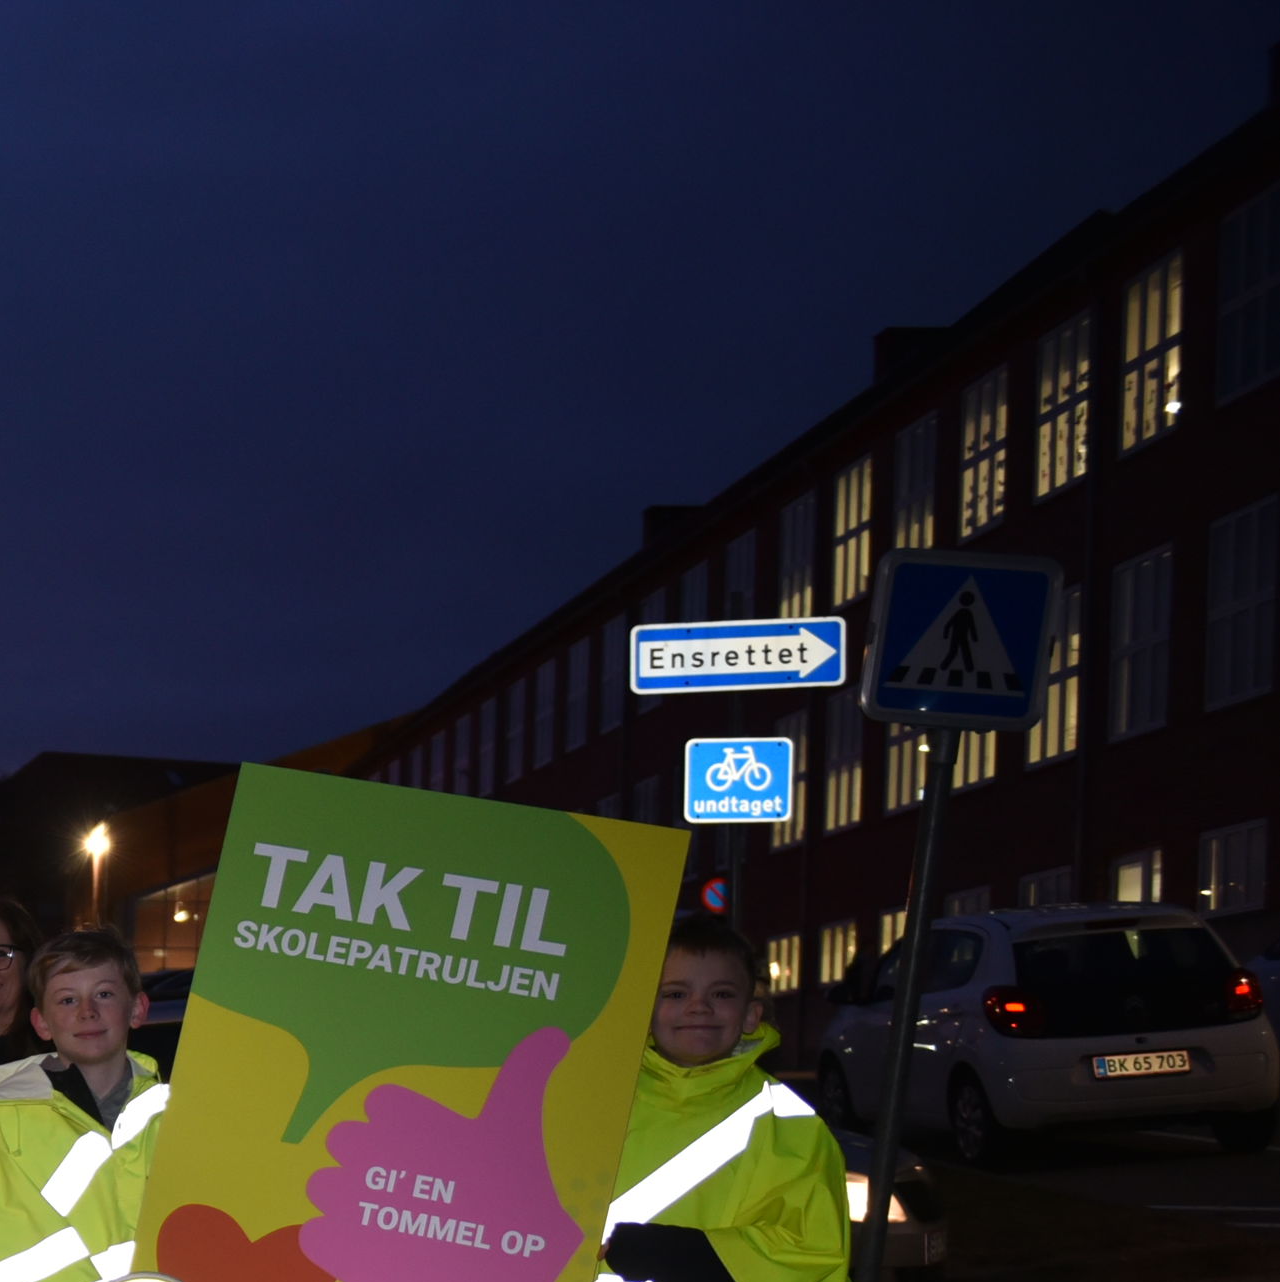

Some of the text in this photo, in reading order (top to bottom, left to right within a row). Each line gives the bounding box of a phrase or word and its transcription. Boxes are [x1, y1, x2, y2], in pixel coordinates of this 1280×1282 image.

[649, 642, 808, 669] Ensrettet
[693, 795, 783, 816] undtaget
[253, 842, 567, 957] TAK TIL
[233, 920, 560, 1001] SKOLEPATRULJEN
[1107, 1053, 1187, 1073] BK 65 703
[413, 1174, 456, 1204] EN
[358, 1201, 546, 1258] TOMMEL OP
